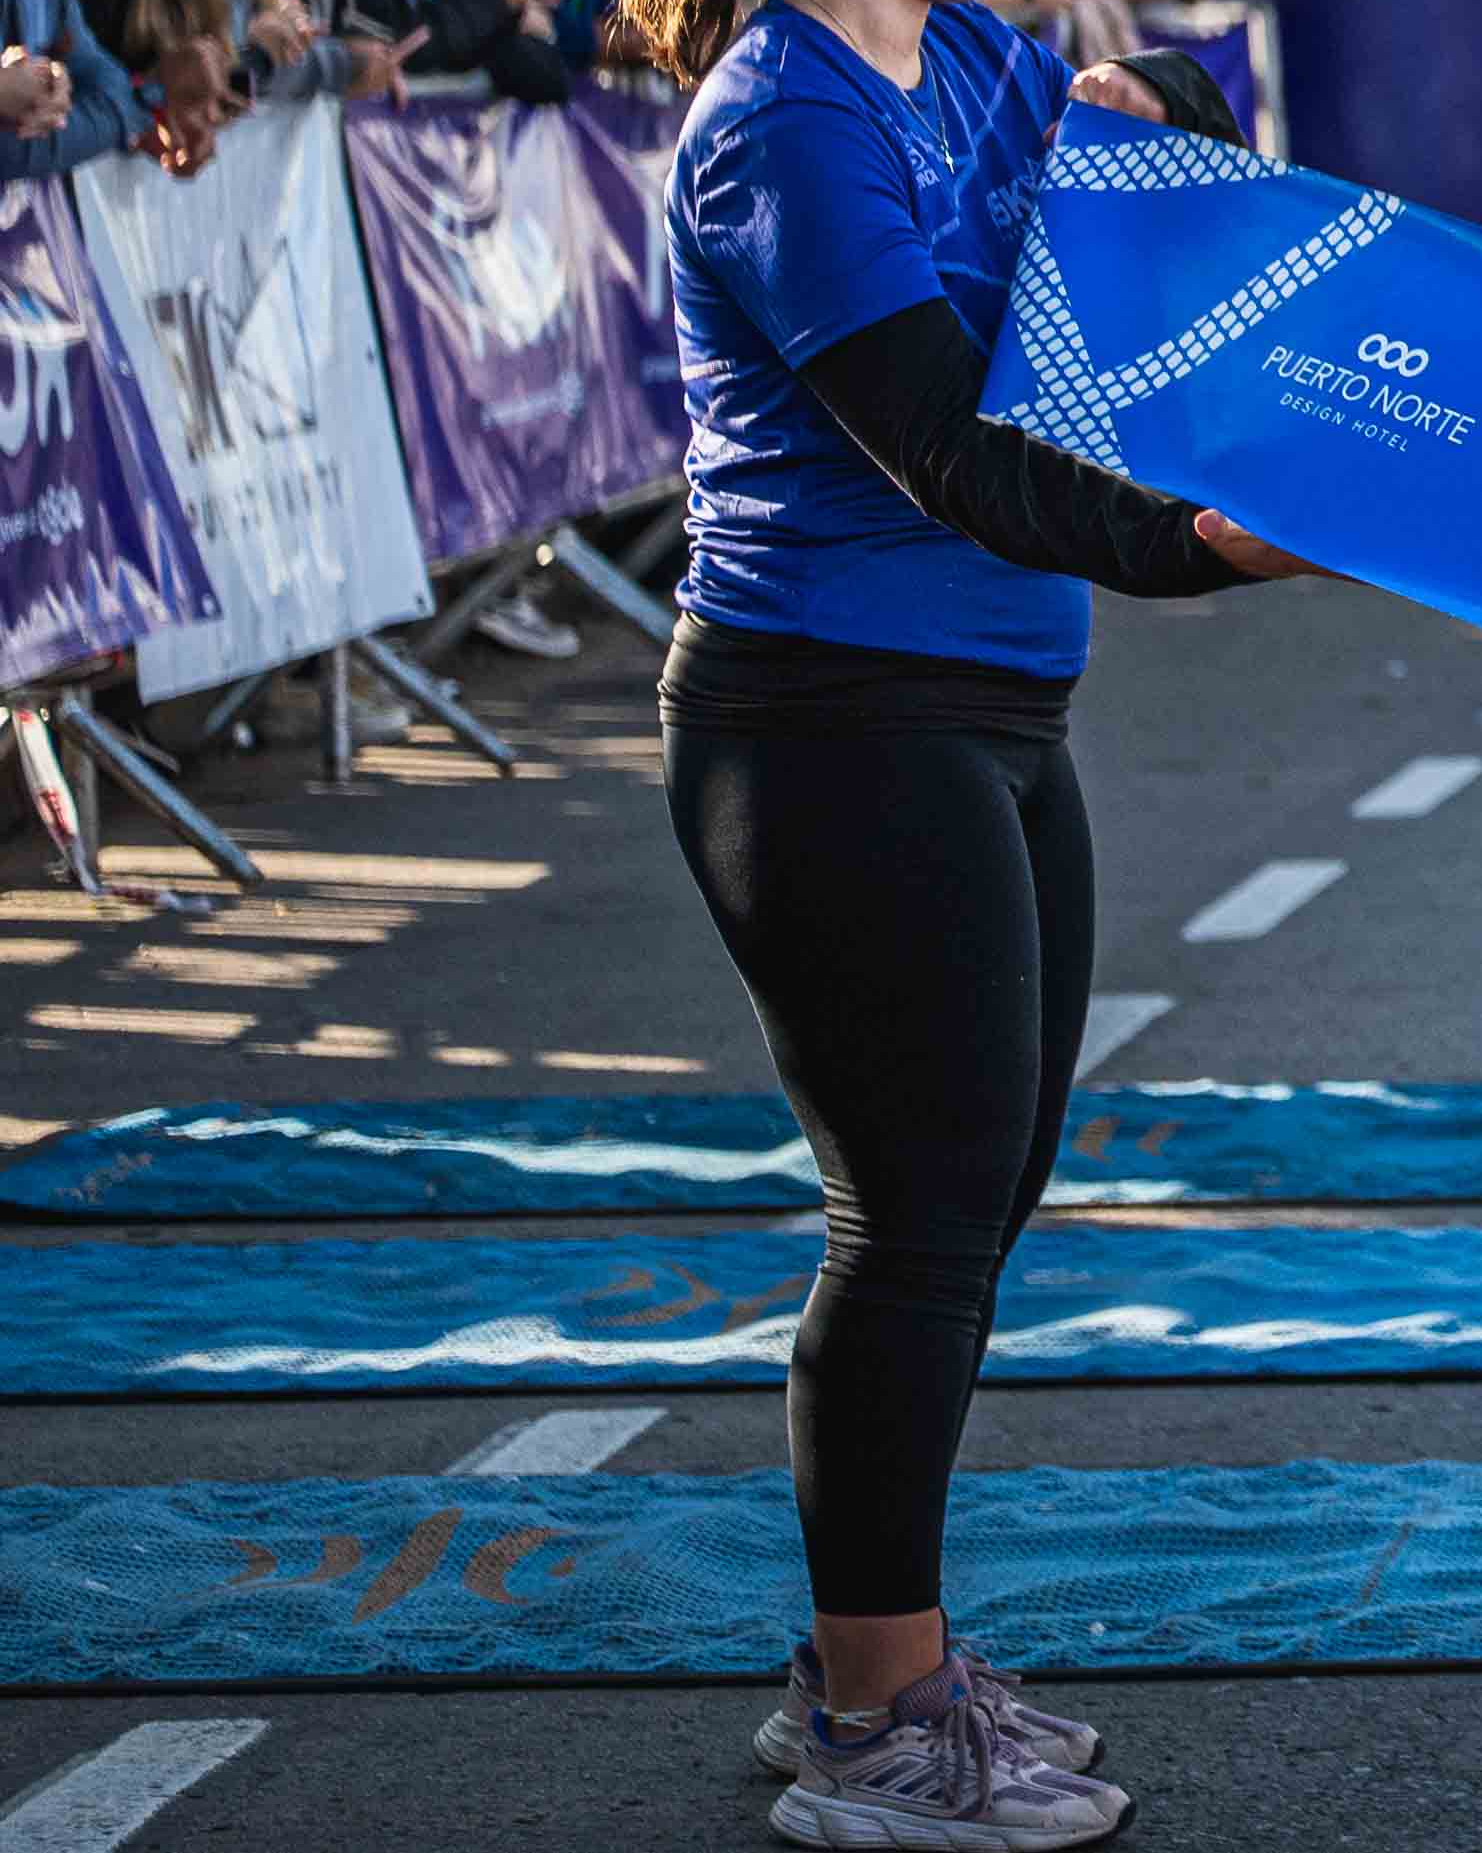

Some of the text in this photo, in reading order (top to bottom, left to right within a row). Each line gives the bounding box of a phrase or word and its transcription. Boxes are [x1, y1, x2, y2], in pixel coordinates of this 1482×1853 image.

[1260, 344, 1476, 445] PUERTO NORTE
[1279, 392, 1409, 452] DESIGN HOTEL
